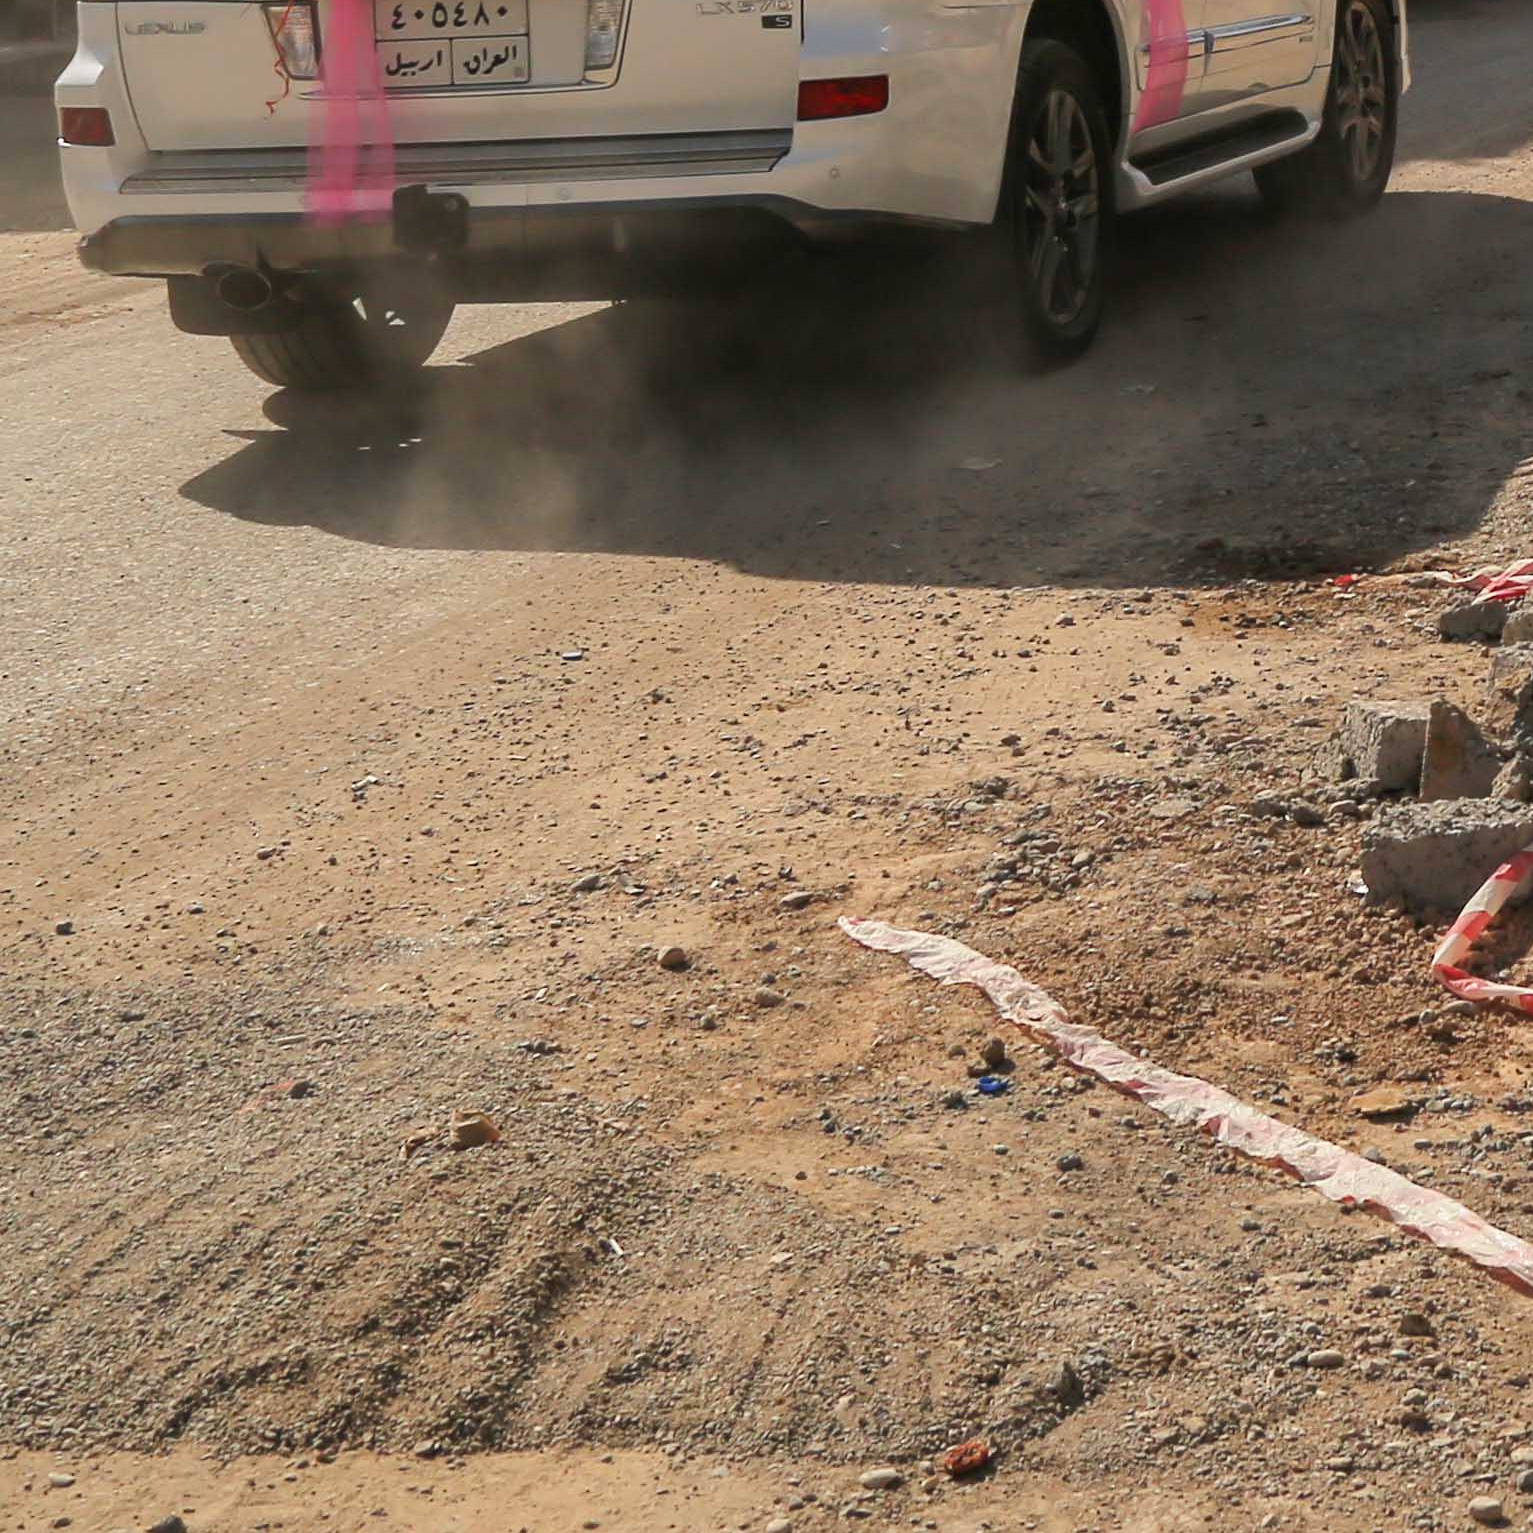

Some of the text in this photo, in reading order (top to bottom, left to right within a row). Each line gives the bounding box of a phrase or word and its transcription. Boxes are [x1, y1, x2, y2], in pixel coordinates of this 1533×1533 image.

[391, 1, 508, 30] ٤٠٥٤٨٠
[776, 15, 790, 28] S
[125, 19, 208, 36] LEXUS
[463, 45, 518, 75] العراق
